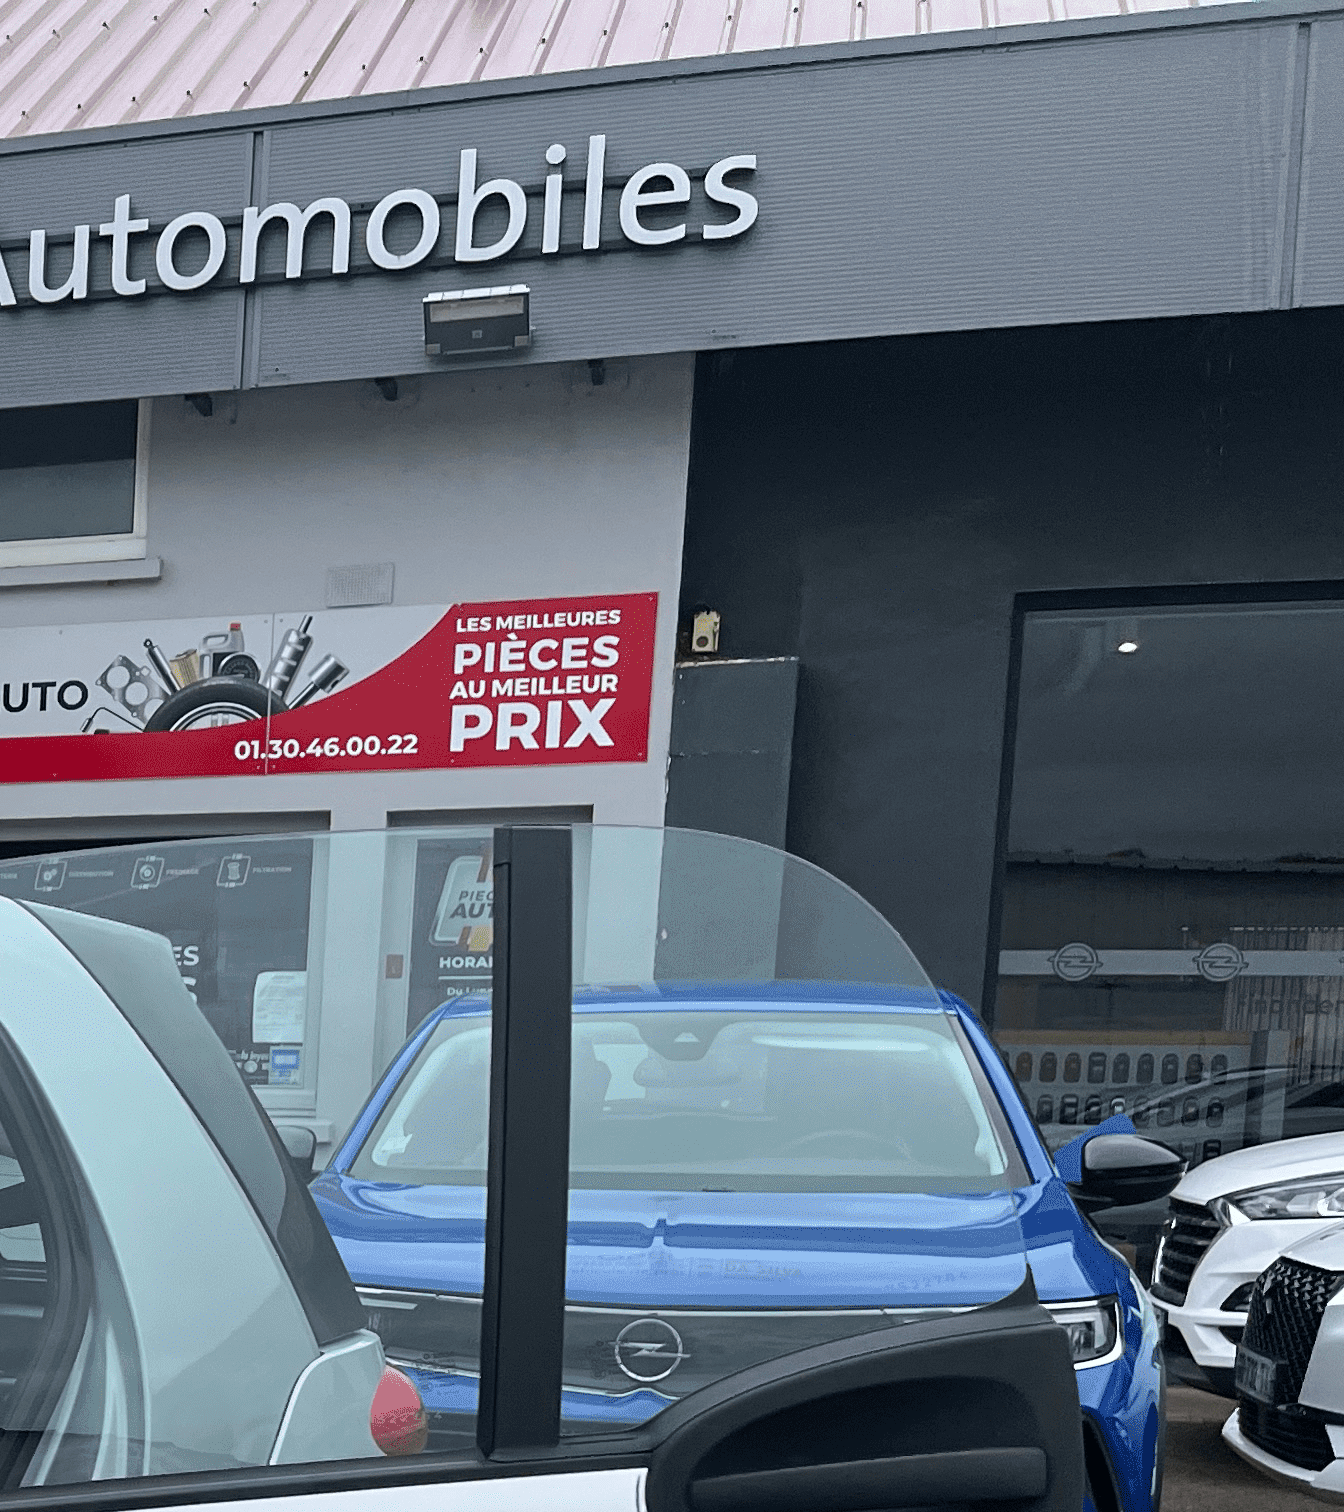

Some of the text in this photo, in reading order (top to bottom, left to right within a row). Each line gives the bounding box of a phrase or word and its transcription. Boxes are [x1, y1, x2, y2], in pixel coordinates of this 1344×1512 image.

[456, 608, 622, 633] LES MEILLEURES
[453, 633, 621, 675] PIÈCES
[448, 674, 619, 699] AU MEILLEUR
[449, 697, 617, 752] PRIX
[233, 734, 419, 760] 01.30.46.00.22
[252, 866, 292, 874] FILTRATION
[458, 890, 494, 902] PIEC
[450, 903, 494, 919] AUT
[438, 955, 493, 969] HORAI
